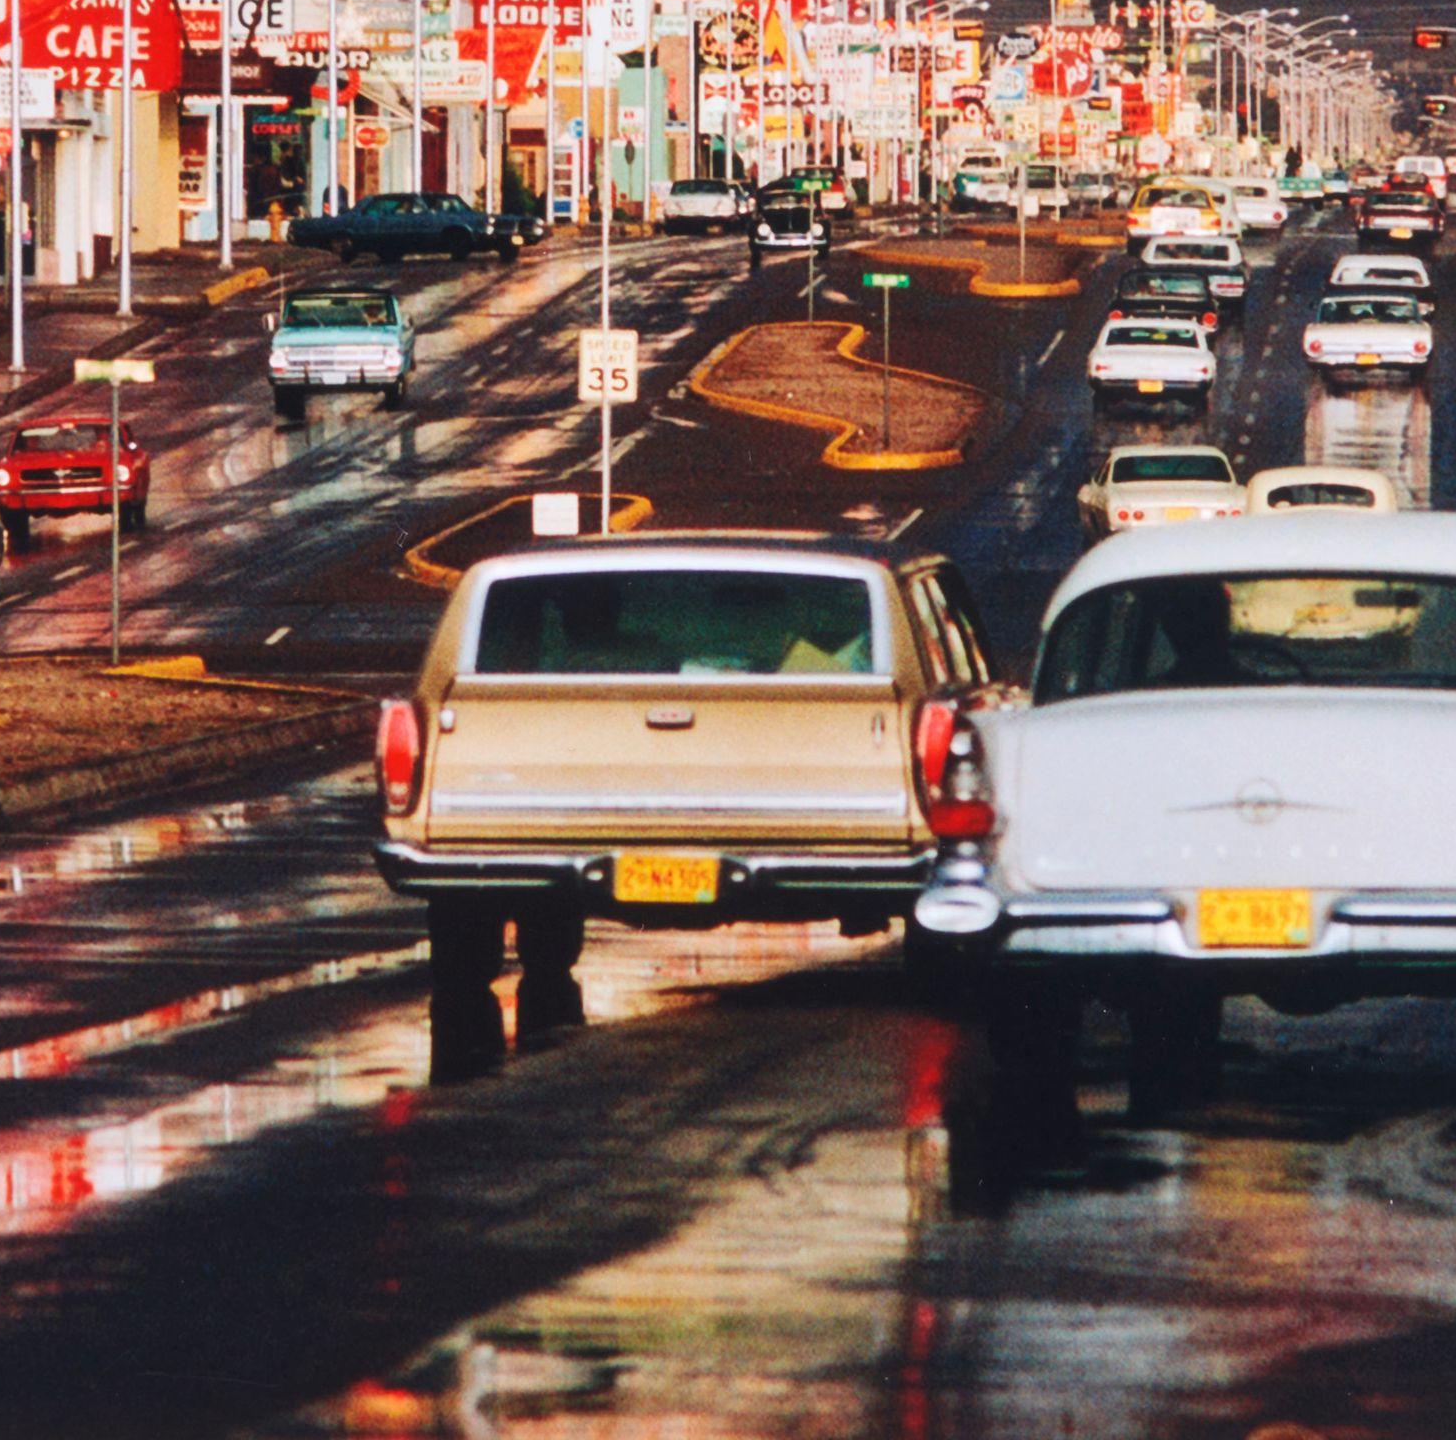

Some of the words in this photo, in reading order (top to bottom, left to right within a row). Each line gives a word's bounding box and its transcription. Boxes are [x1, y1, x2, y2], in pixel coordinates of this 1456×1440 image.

[45, 24, 151, 60] CAFE
[586, 339, 631, 352] SPED
[587, 368, 630, 392] 35
